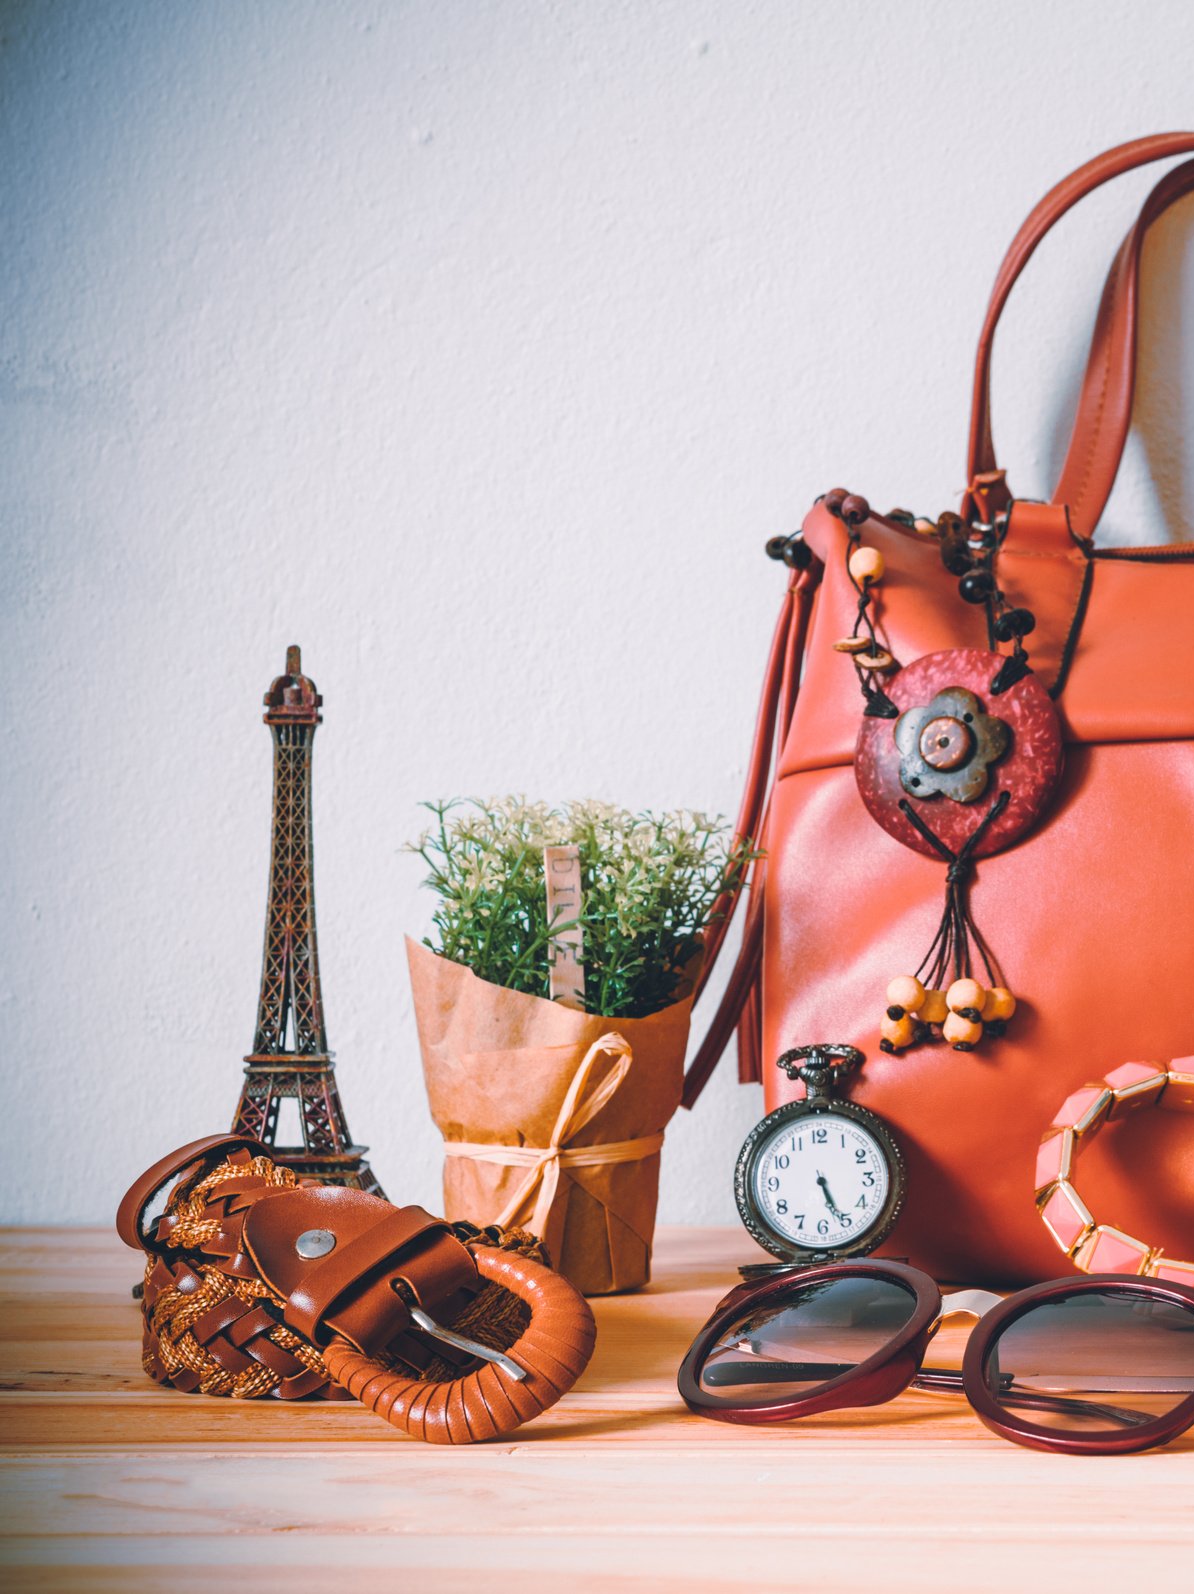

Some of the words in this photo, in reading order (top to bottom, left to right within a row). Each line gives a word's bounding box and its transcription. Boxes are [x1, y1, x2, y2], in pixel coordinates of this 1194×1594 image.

[791, 1136, 803, 1151] 11
[812, 1129, 828, 1144] 12
[841, 1134, 846, 1149] 1
[774, 1154, 790, 1169] 10
[855, 1149, 866, 1164] 2
[768, 1176, 780, 1192] 9
[862, 1171, 875, 1187] 3
[776, 1199, 788, 1214] 8
[854, 1194, 868, 1209] 4
[794, 1214, 806, 1230] 7
[817, 1219, 829, 1235] 6
[840, 1212, 852, 1228] 5
